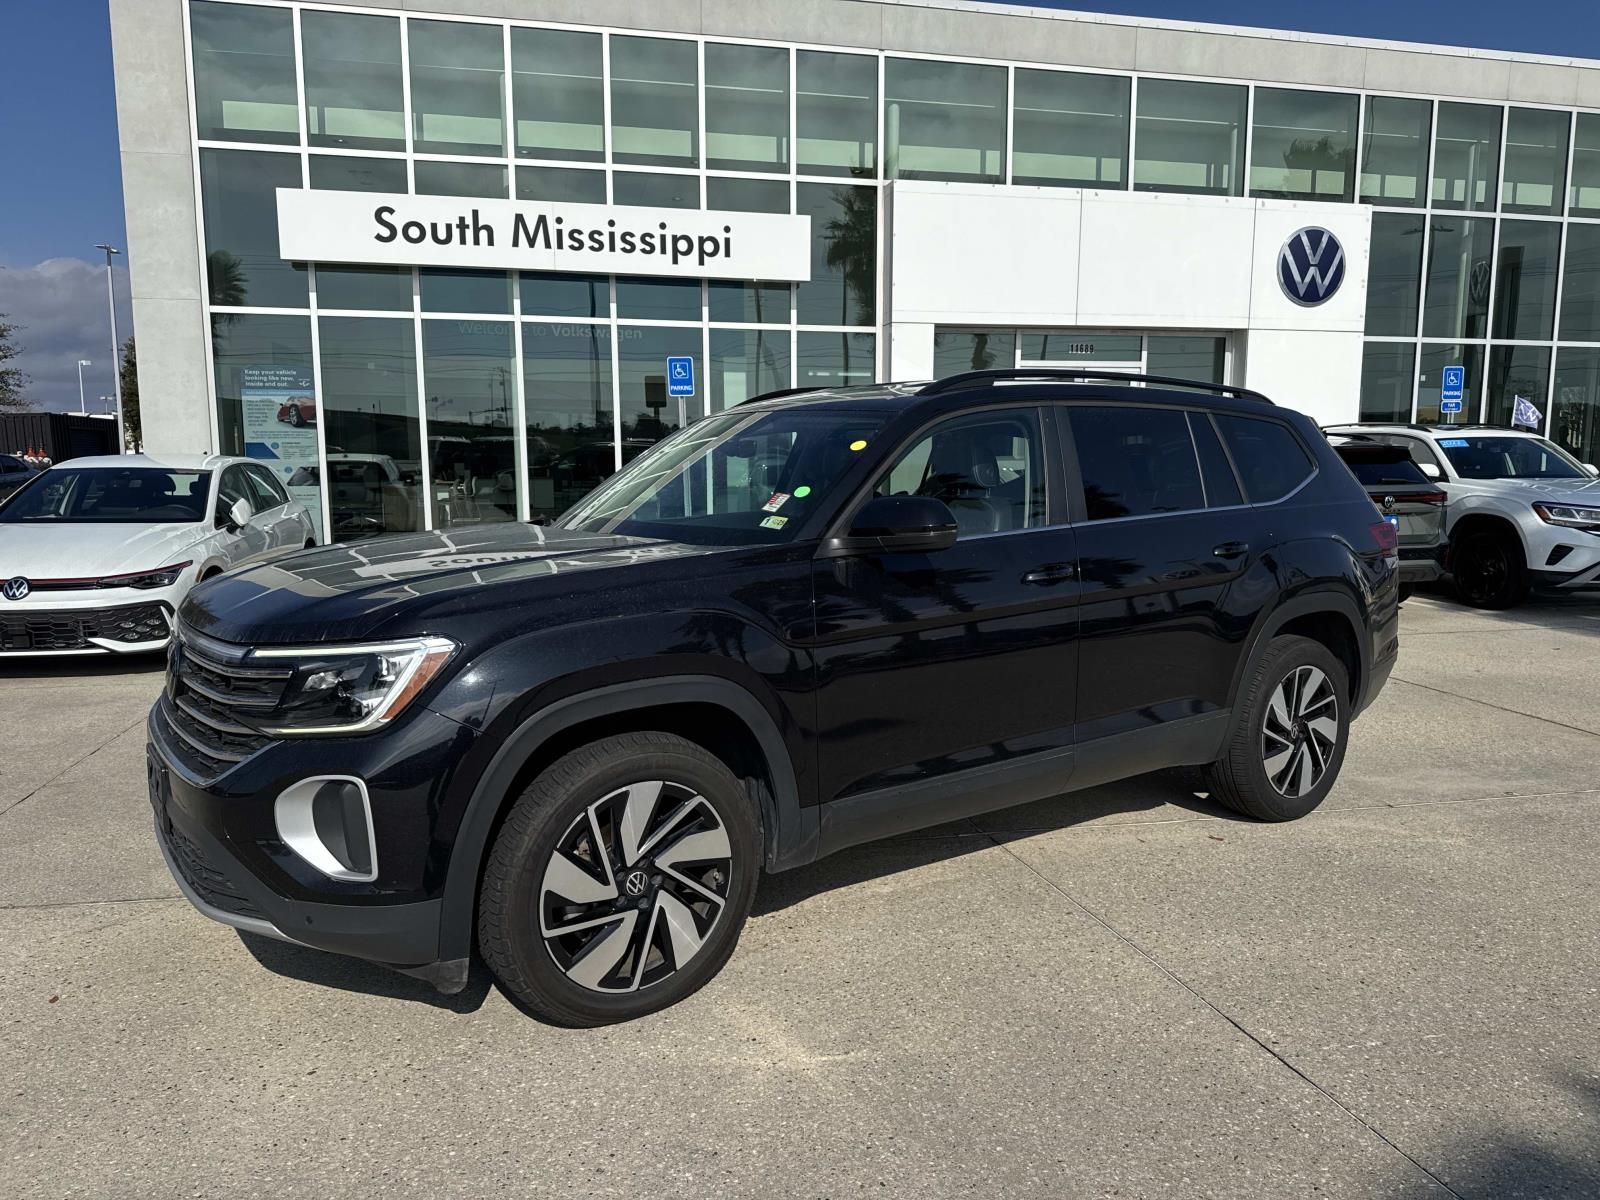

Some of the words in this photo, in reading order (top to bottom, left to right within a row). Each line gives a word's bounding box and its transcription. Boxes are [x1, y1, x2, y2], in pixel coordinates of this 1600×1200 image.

[374, 206, 495, 246] South
[512, 212, 732, 266] Mississippi
[1279, 227, 1345, 304] VW
[532, 325, 546, 337] to
[3, 577, 28, 600] VW
[626, 872, 648, 895] VW
